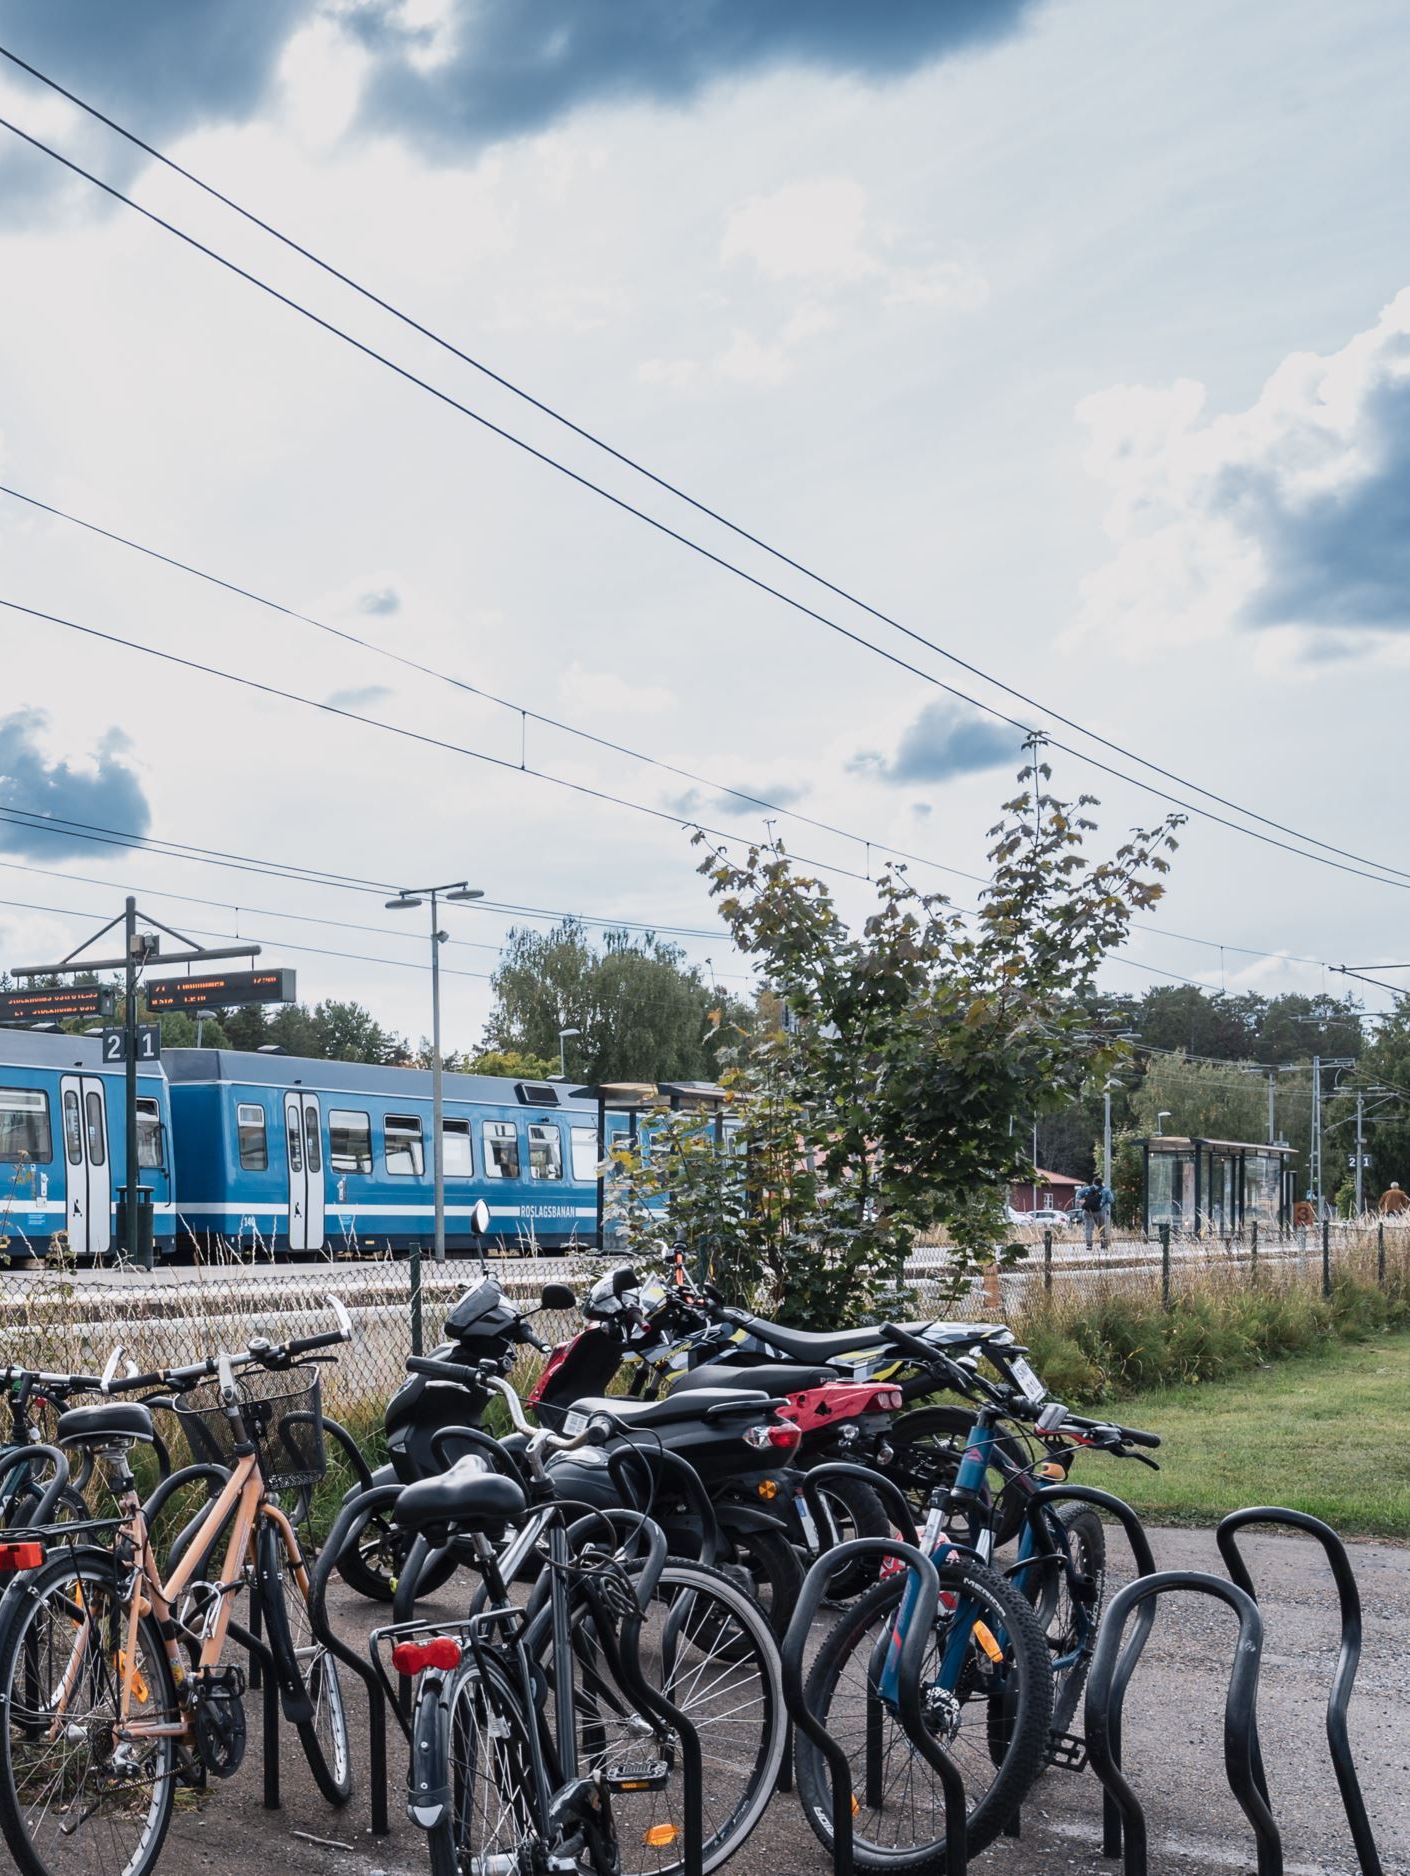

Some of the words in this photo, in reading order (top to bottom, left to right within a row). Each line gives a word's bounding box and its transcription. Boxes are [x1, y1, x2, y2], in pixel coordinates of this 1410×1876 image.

[108, 1035, 121, 1059] 2
[142, 1033, 154, 1057] 1
[1349, 1157, 1356, 1167] 2
[1363, 1157, 1370, 1167] 1
[520, 1205, 575, 1218] ROSLAGSBANAN
[963, 1577, 1006, 1617] MERIDA
